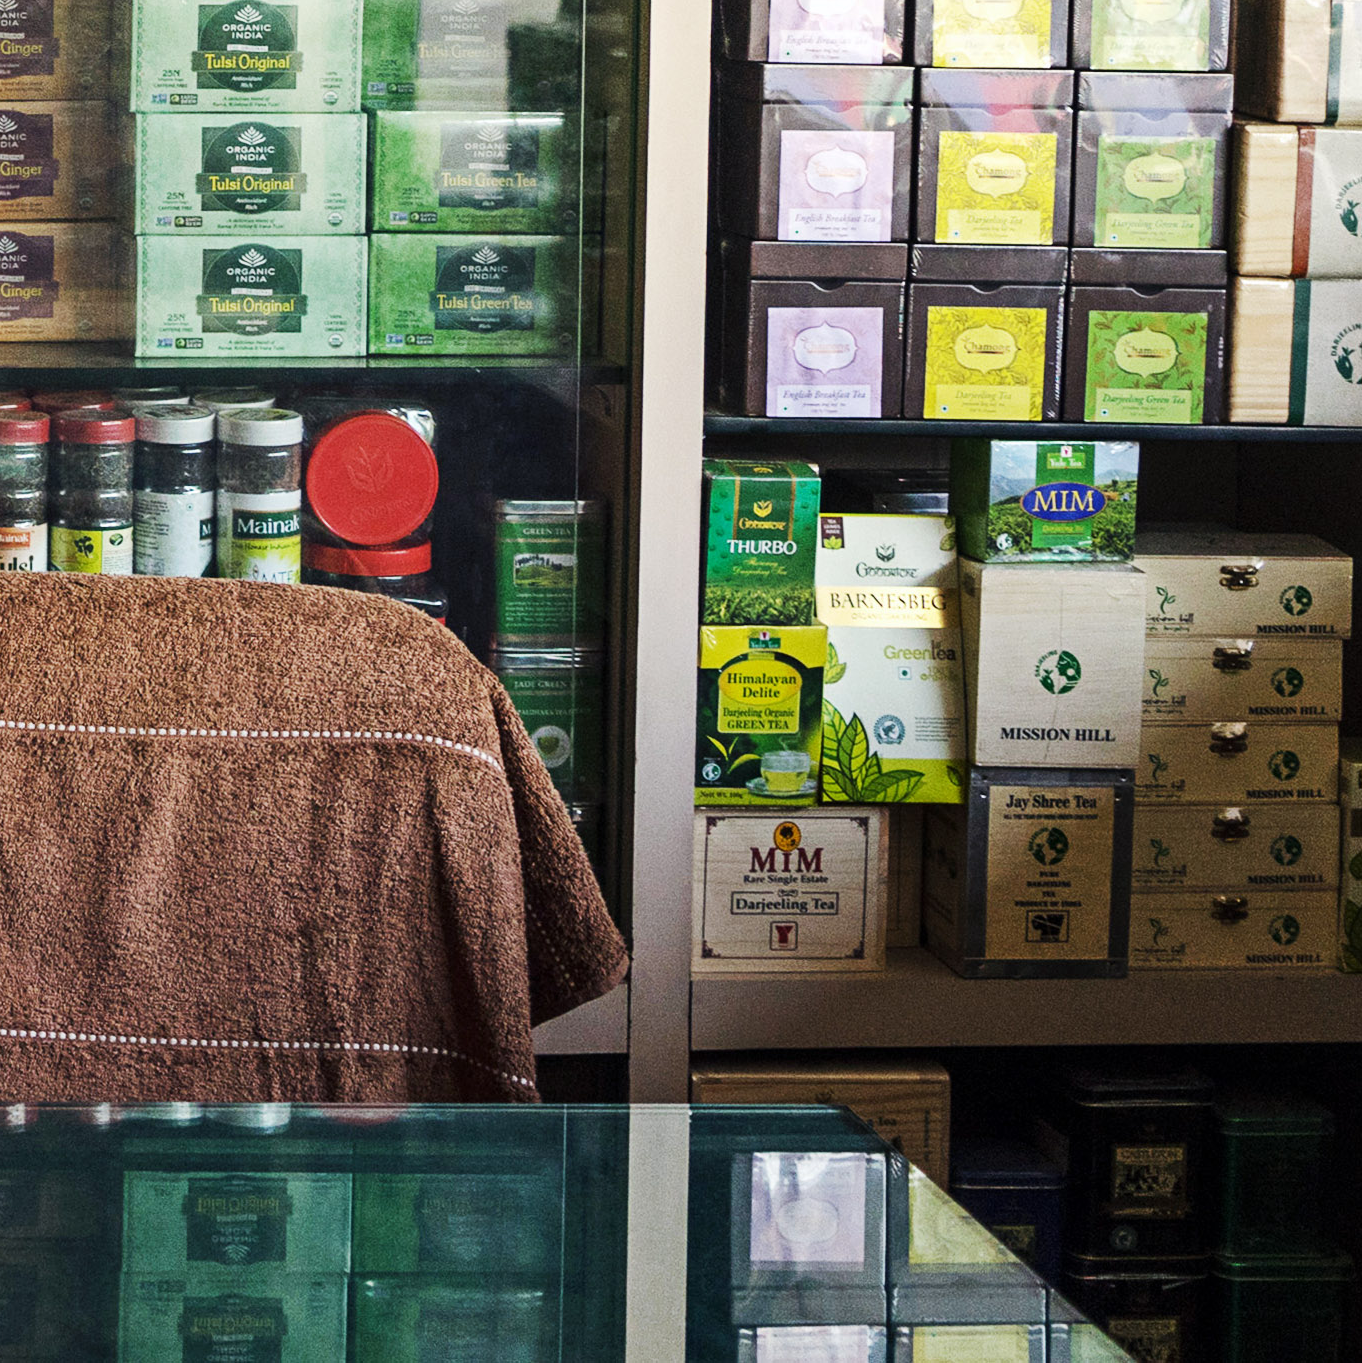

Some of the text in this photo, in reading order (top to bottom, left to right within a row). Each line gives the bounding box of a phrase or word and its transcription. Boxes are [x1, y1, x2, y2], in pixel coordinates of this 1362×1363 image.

[1034, 492, 1094, 513] MIM
[237, 518, 299, 533] Mainak
[727, 540, 796, 555] THURBO
[830, 594, 946, 610] BARNESBEG
[1257, 625, 1337, 634] MISSION HILL
[727, 673, 797, 686] Himalayan
[743, 687, 780, 699] Delite
[723, 708, 794, 719] Darjeeling Organic
[728, 720, 789, 729] GREEN TEA
[1001, 728, 1115, 742] MISSION HILL
[1006, 795, 1097, 811] Jay Shree Tea
[743, 873, 829, 887] Rare Single Estate
[735, 896, 835, 913] Darjeeling Tea
